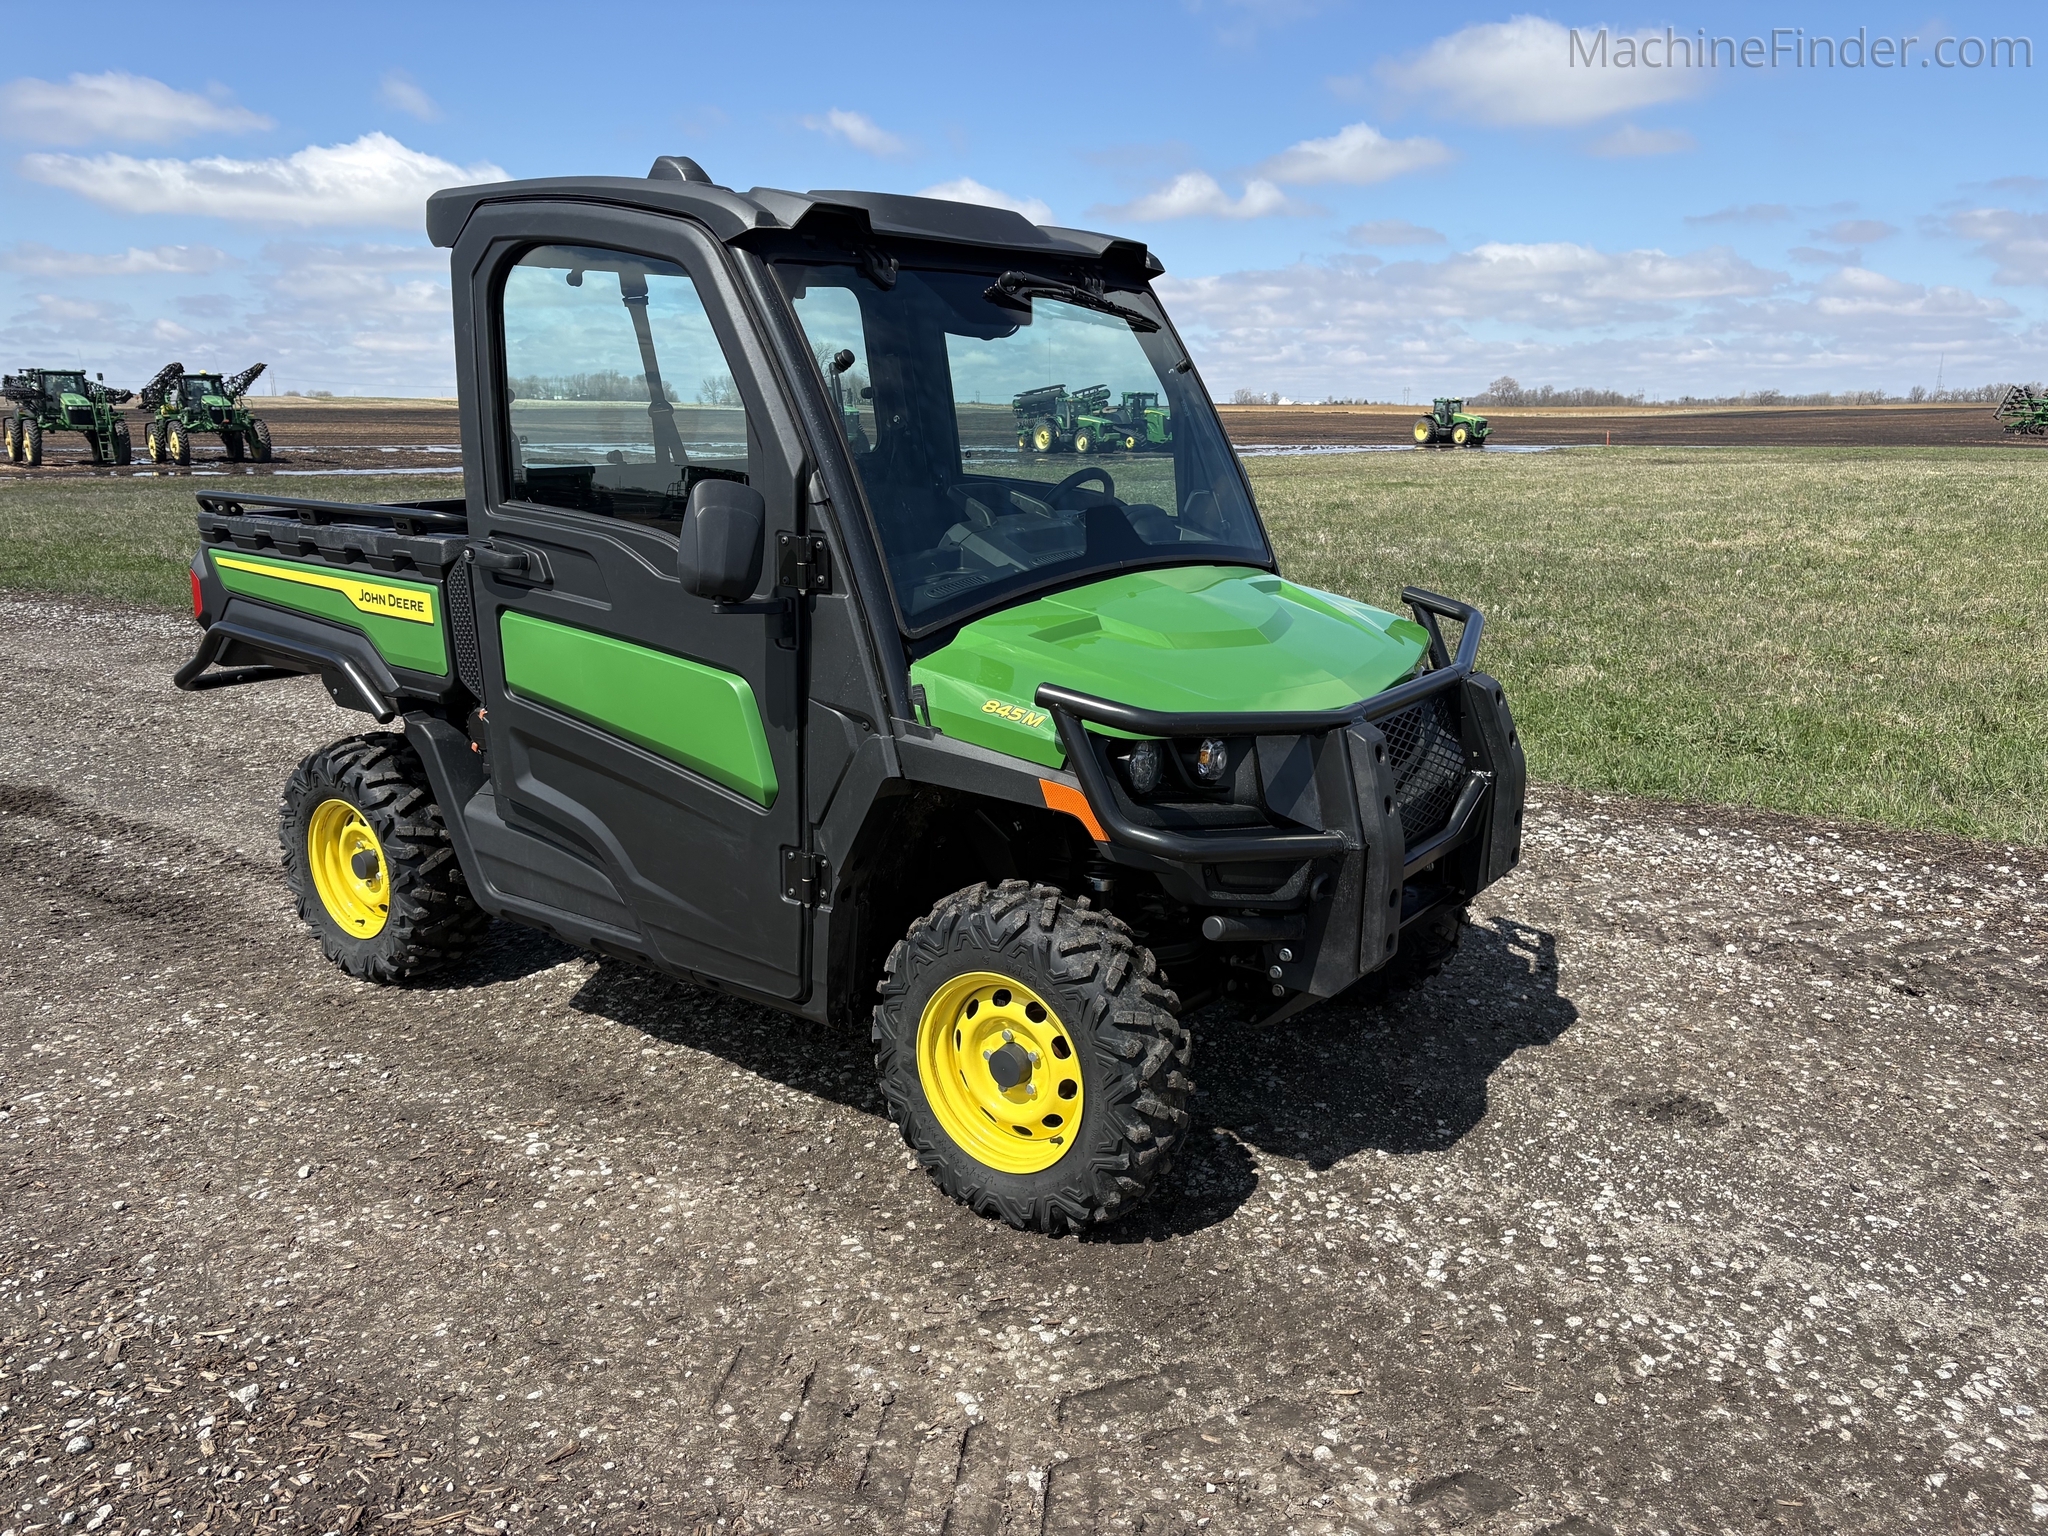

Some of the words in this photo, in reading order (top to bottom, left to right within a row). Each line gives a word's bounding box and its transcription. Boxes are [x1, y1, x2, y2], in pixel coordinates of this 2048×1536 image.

[359, 589, 386, 605] JOHN
[388, 594, 424, 612] DEERE
[982, 700, 1047, 728] 845M
